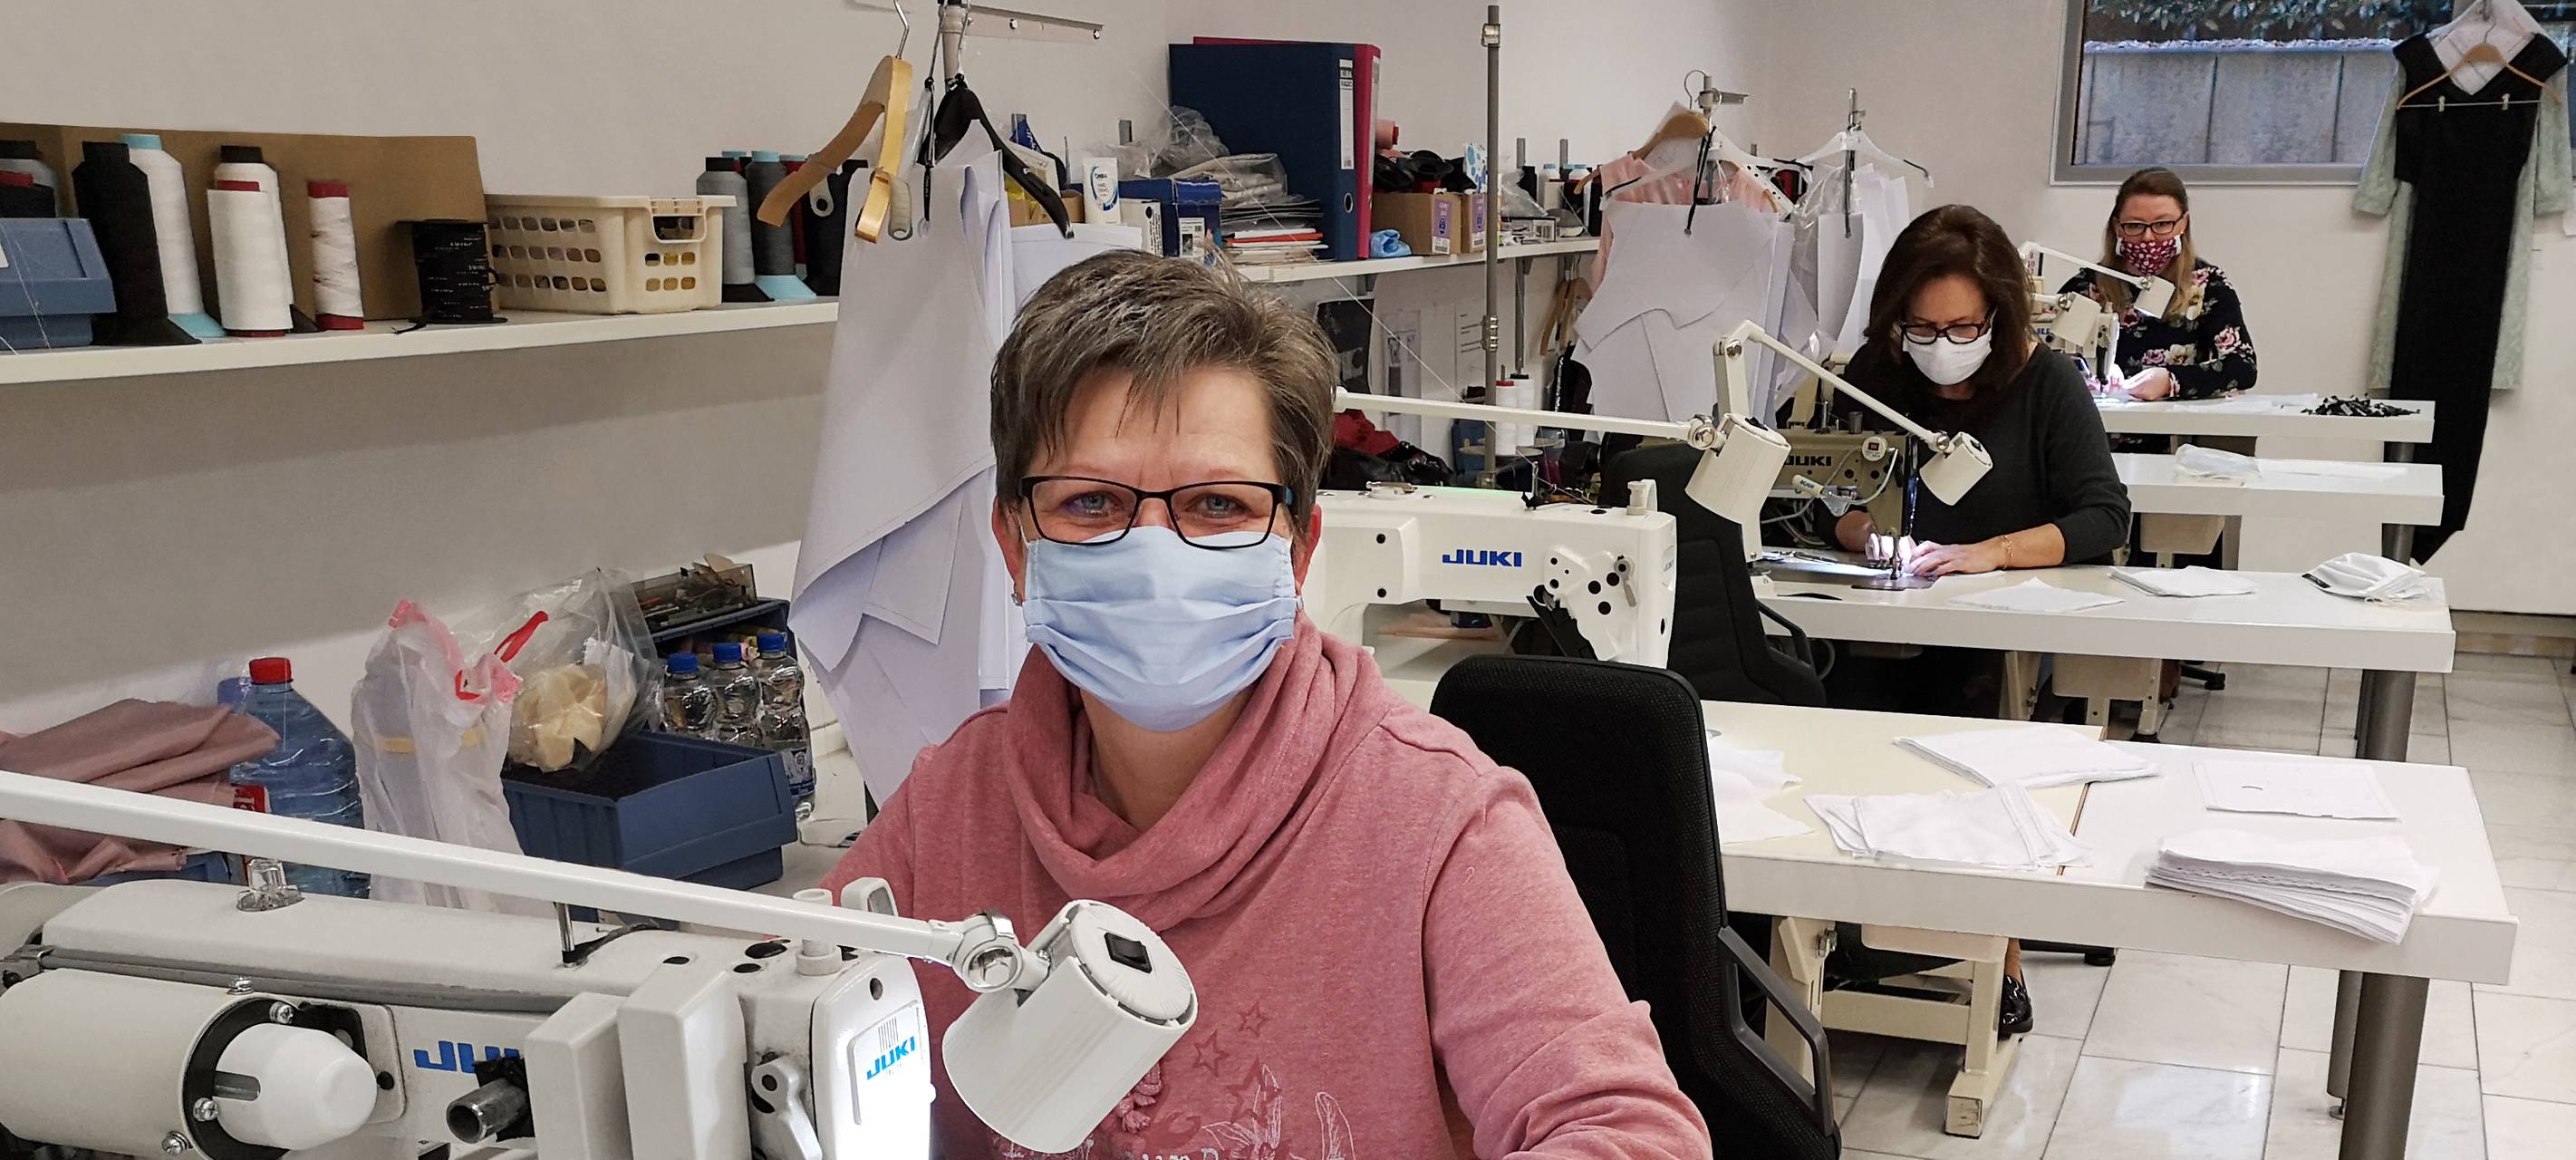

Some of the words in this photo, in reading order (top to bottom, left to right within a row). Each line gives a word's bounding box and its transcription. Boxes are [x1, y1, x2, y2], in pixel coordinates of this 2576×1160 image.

[1784, 456, 1832, 467] JUKI
[1442, 549, 1522, 567] JUKI
[413, 1040, 521, 1074] JU
[866, 1036, 915, 1080] JUKI
